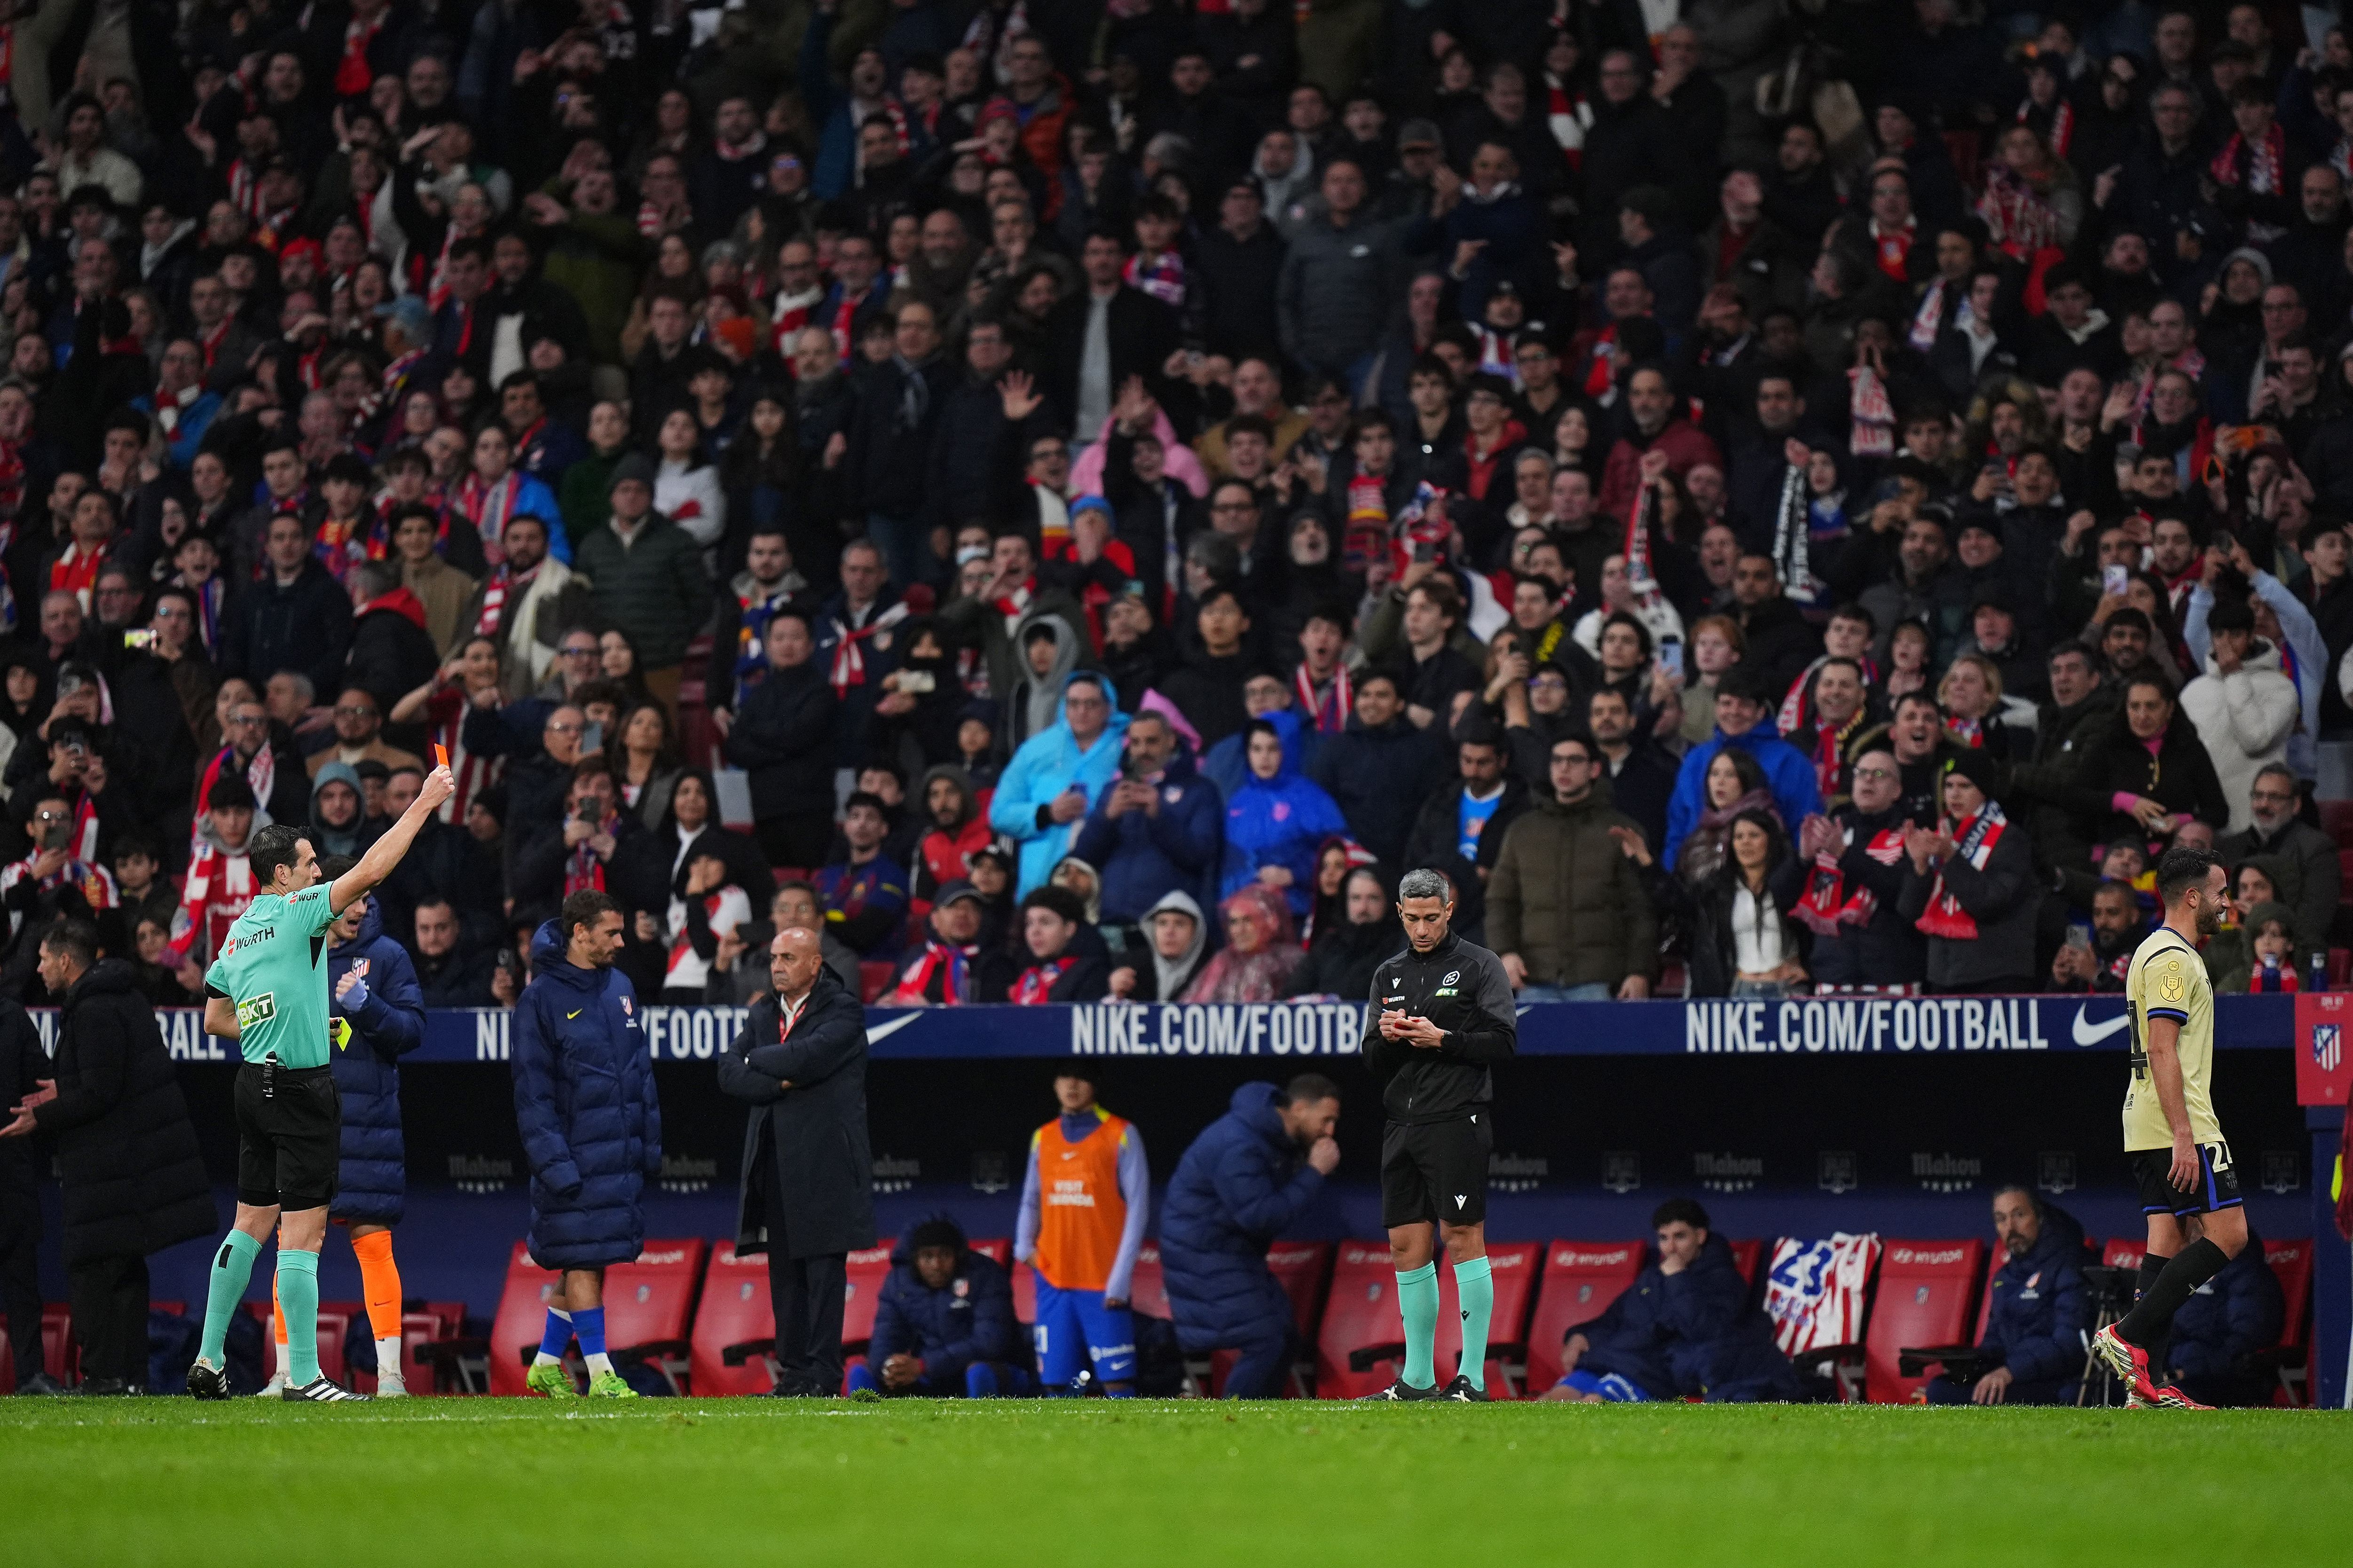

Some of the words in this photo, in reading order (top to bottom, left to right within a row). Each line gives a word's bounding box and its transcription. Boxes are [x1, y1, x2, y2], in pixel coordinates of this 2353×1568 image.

[299, 891, 320, 902] WÜR
[236, 926, 275, 950] WÜRTH
[238, 996, 273, 1025] BKT
[1072, 1004, 1369, 1054] NIKE.COM/FOOTB
[1686, 999, 2048, 1052] NIKE.COM/FOOTBALL
